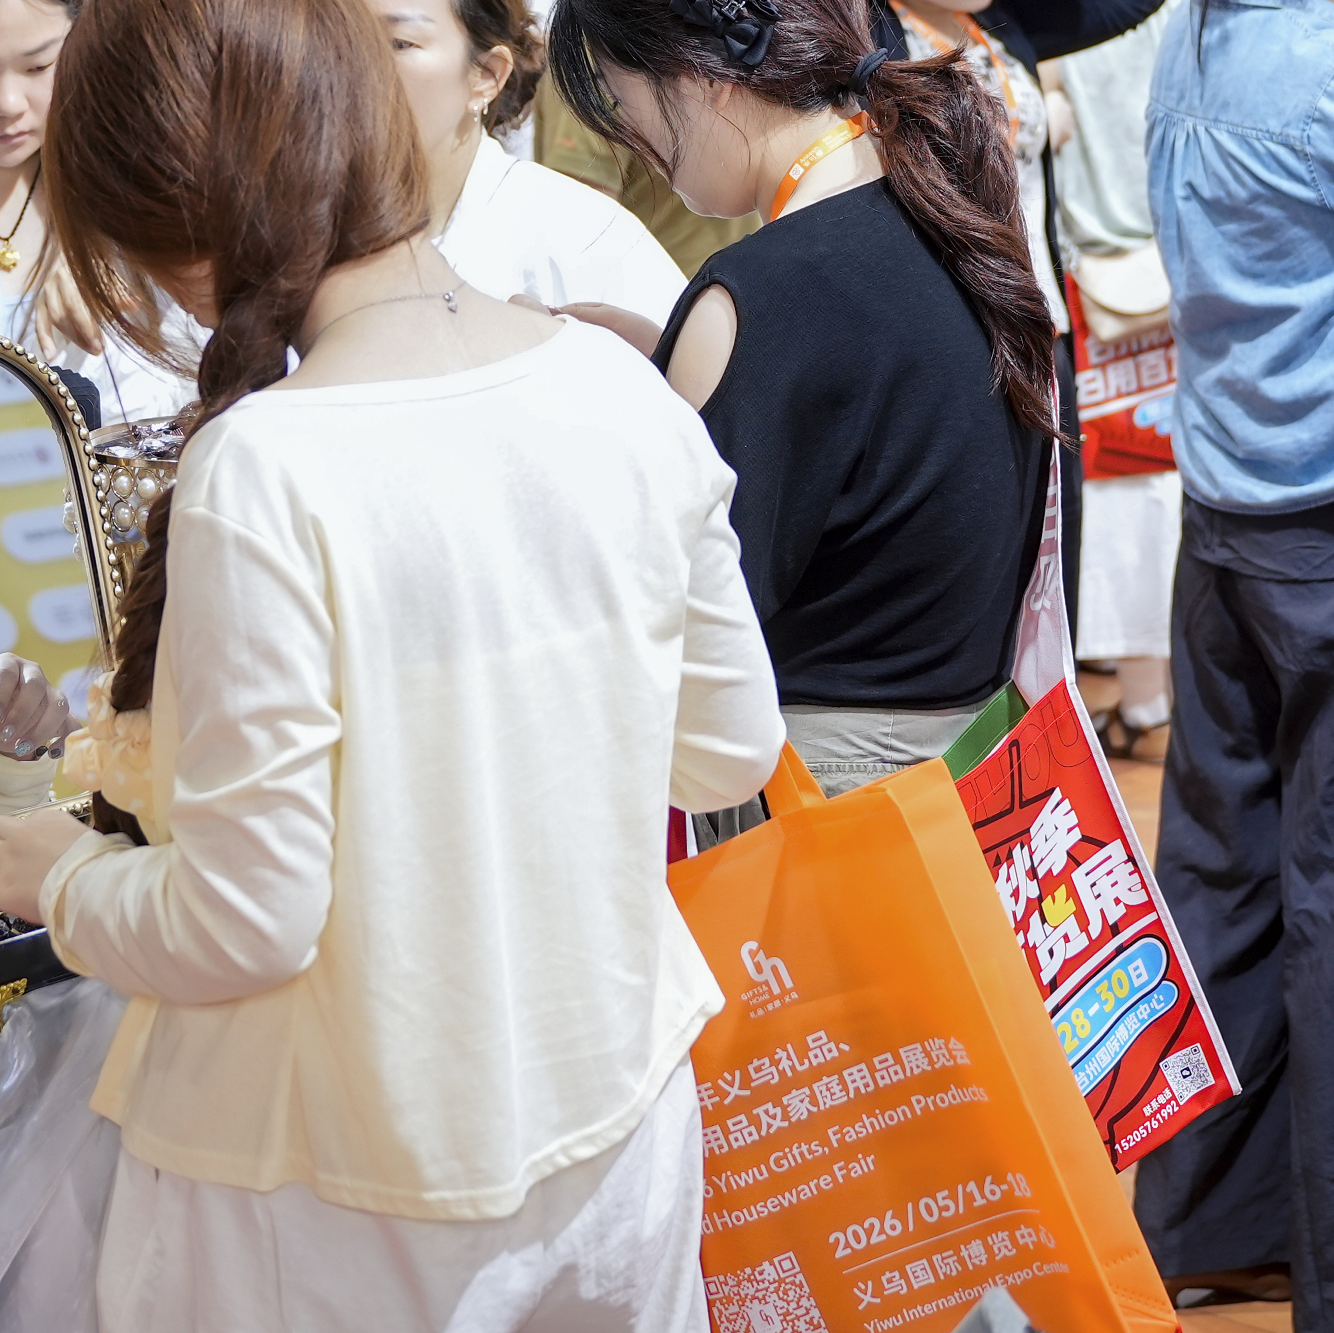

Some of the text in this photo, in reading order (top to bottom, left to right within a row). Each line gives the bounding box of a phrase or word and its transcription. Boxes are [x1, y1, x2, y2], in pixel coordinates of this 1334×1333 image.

[1016, 838, 1150, 986] 货展
[748, 992, 771, 1006] HOME
[1056, 957, 1149, 1055] 28-30日
[1075, 992, 1166, 1090] 台州国际博览中心
[701, 1036, 971, 1158] 用品及家庭用品展览会
[713, 1163, 769, 1194] Yiwu
[769, 1137, 829, 1173] Gifts,
[827, 1100, 913, 1149] Fashion
[910, 1083, 989, 1116] Products
[1114, 1099, 1180, 1155] 15205761992
[1142, 1087, 1174, 1118] 联系电话
[713, 1174, 834, 1232] Houseware
[832, 1152, 877, 1184] Fair
[852, 1223, 1057, 1311] 义乌国际博览中心
[902, 1277, 994, 1321] International
